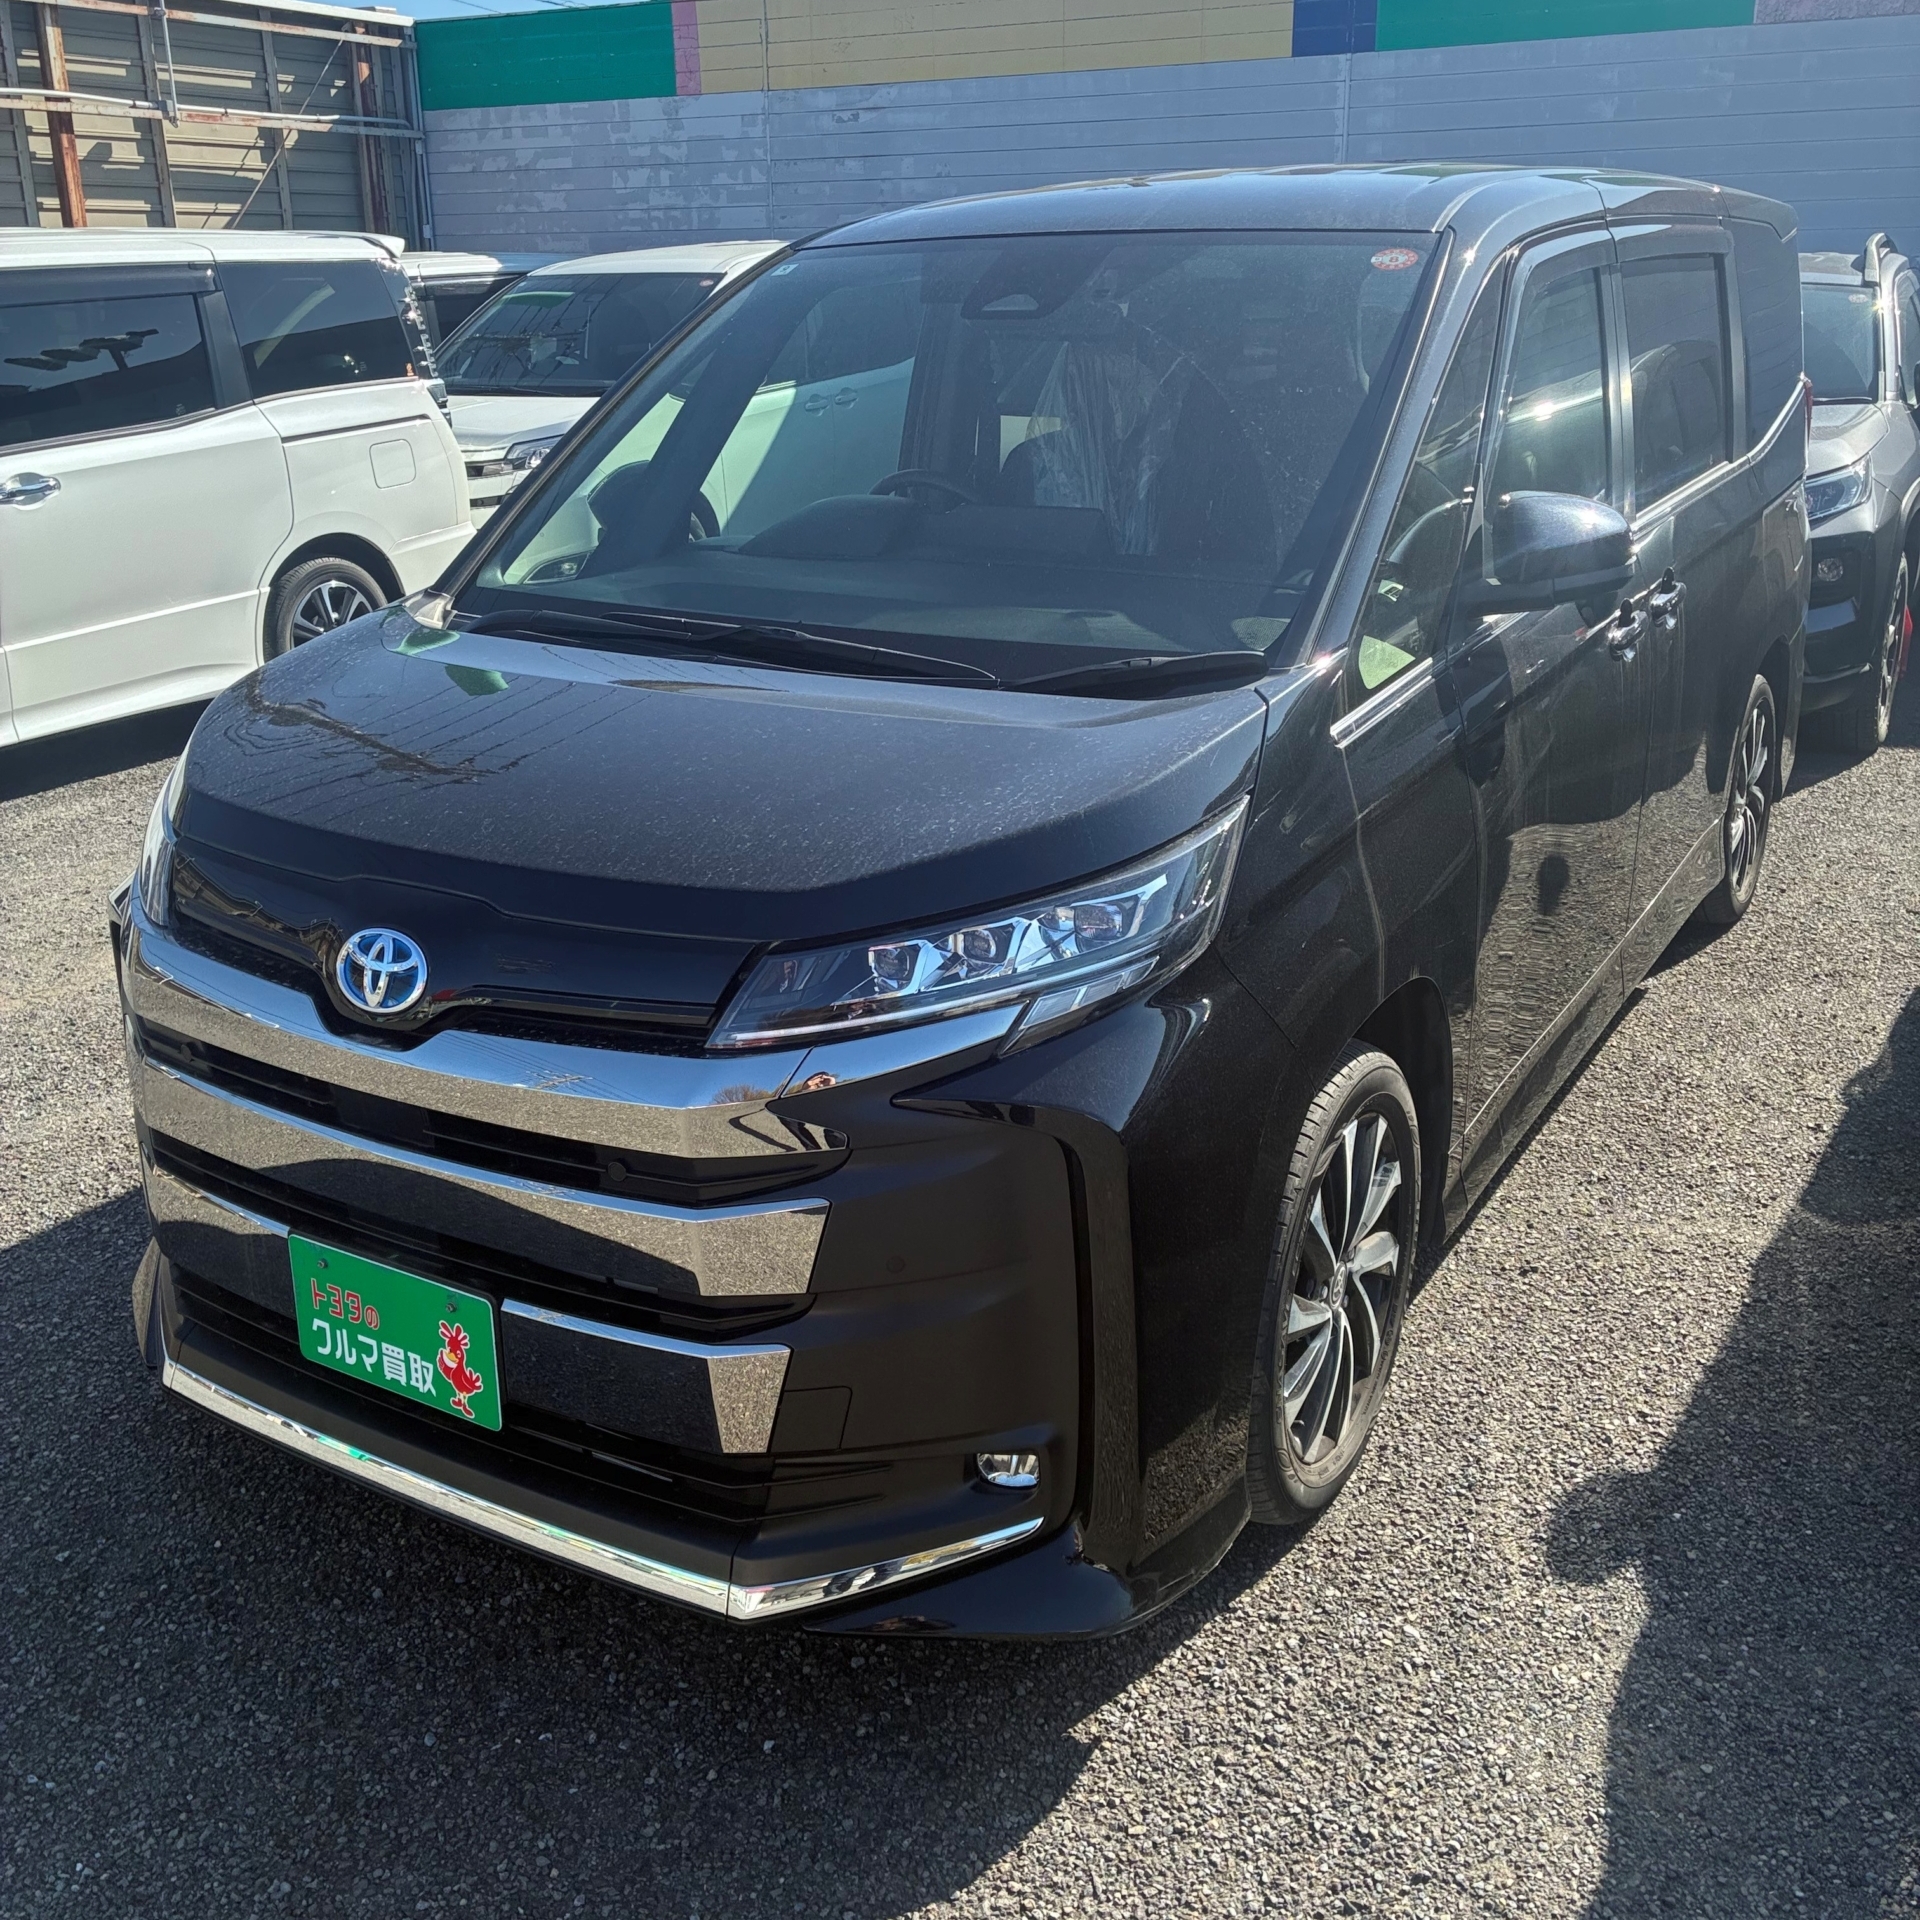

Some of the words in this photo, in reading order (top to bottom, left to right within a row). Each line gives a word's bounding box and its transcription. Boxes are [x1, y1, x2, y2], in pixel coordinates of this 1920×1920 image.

[311, 1278, 380, 1330] トヨタの
[312, 1318, 436, 1397] クルマ買取
